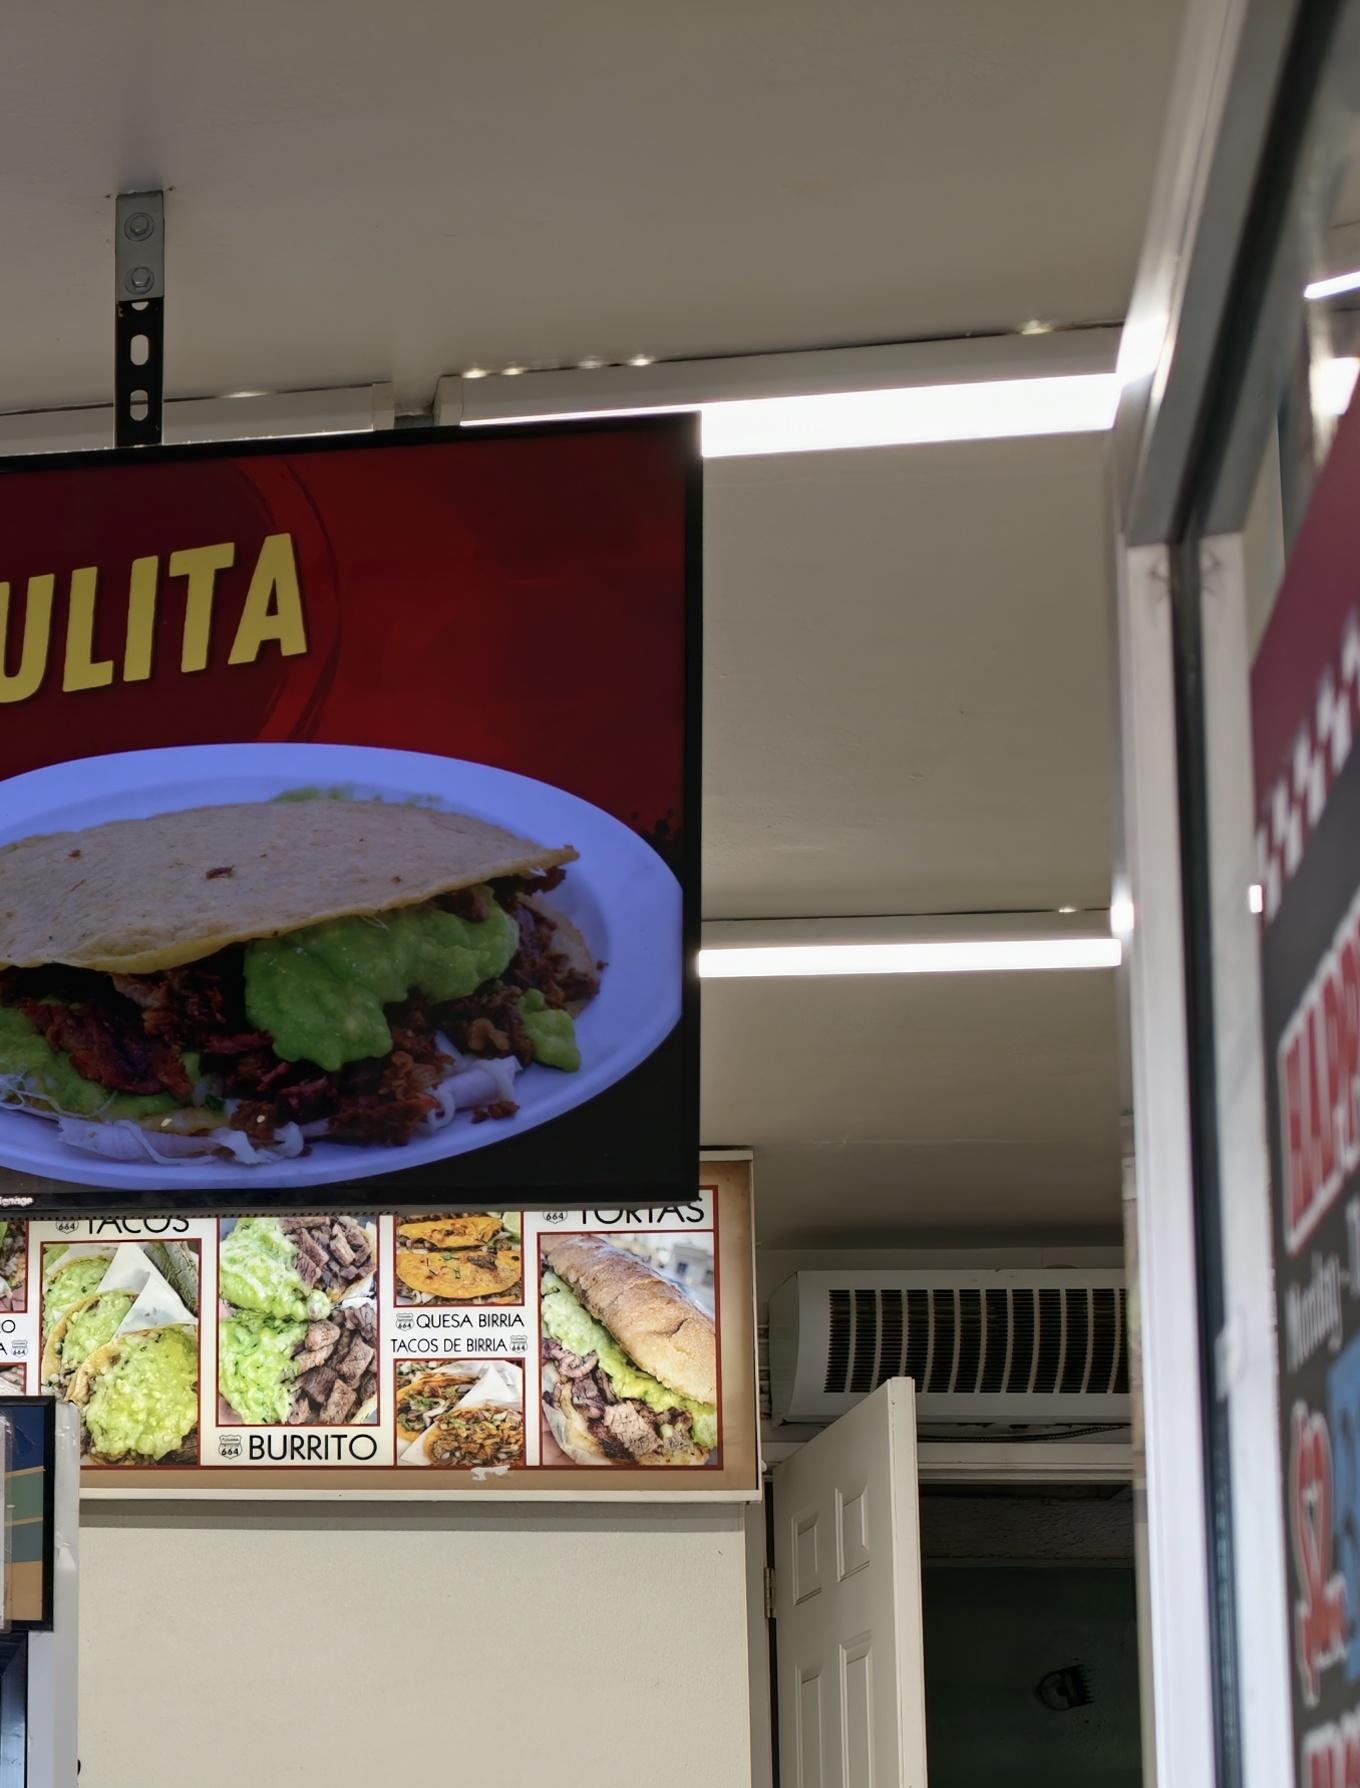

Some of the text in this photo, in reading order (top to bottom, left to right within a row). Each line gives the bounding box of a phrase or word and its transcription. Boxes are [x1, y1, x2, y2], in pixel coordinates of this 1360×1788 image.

[416, 1313, 525, 1329] QUESA BIRRIA
[390, 1338, 508, 1353] TACOS DE BIRRIA
[249, 1434, 377, 1460] BURRITO
